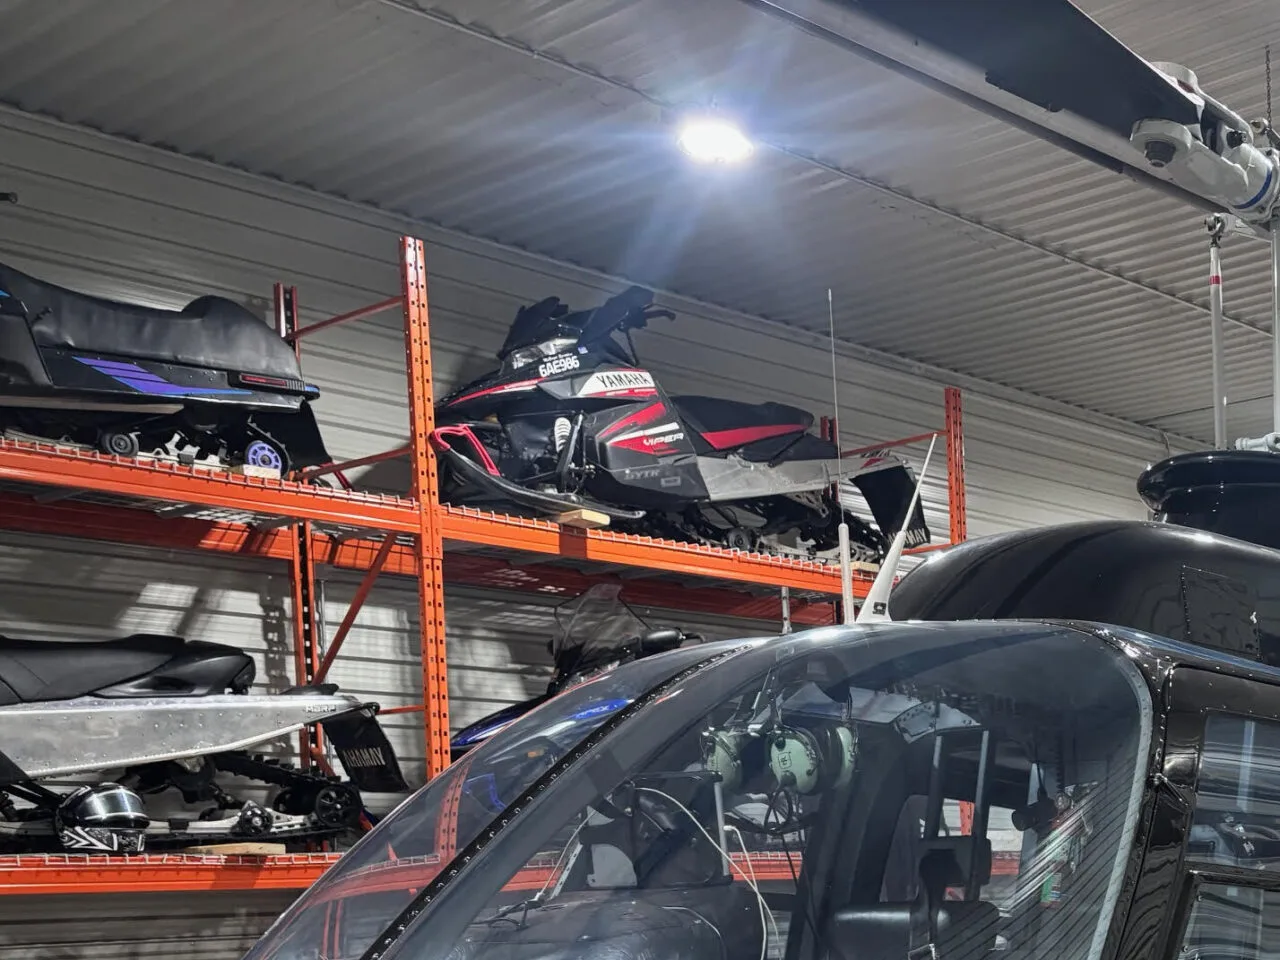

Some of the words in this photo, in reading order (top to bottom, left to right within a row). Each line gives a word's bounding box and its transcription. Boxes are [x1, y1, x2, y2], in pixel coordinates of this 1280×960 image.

[538, 355, 580, 378] 6AE986
[596, 373, 651, 388] YAMAHA
[642, 432, 684, 446] VIPER
